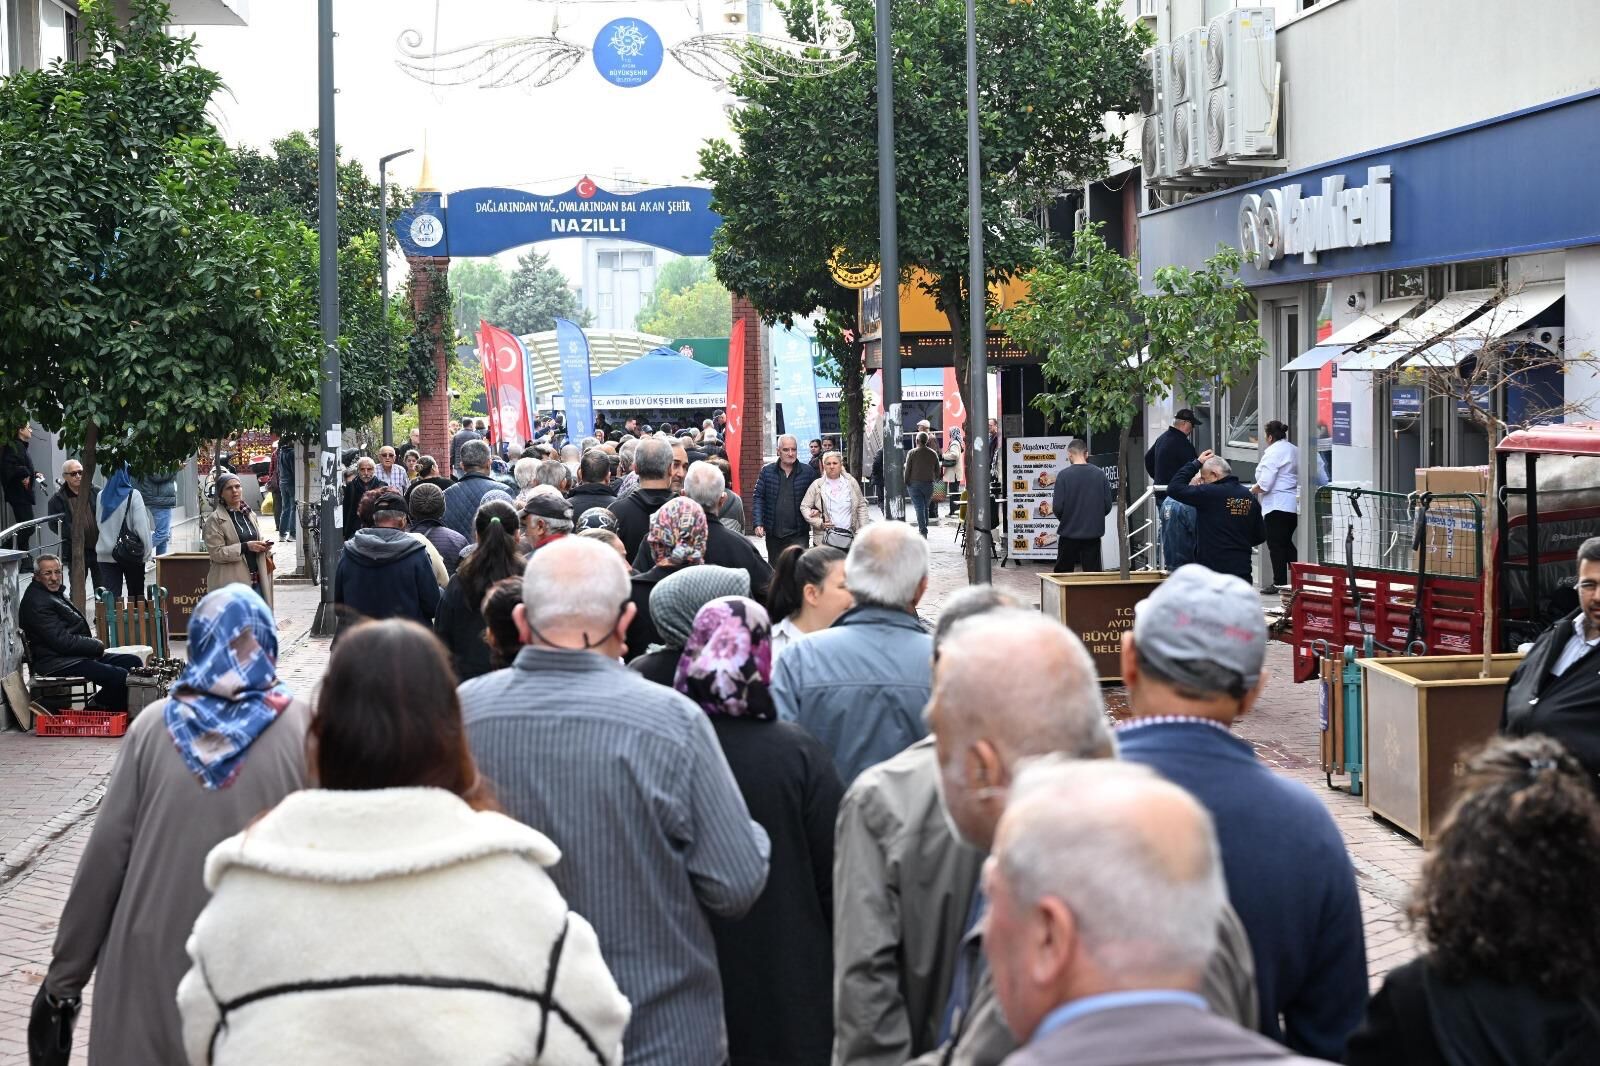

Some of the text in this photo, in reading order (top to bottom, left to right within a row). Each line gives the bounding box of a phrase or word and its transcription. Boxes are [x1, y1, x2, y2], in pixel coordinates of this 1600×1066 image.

[475, 199, 537, 213] DAĞLARINDAN
[621, 201, 637, 212] BAL
[640, 201, 665, 212] AKAN
[667, 200, 692, 214] ŞEHİR
[906, 390, 944, 399] BELEDİYES
[629, 396, 684, 407] BÜYÜKŞEHİR
[686, 396, 726, 405] BELEDİYESİ
[1115, 607, 1135, 617] T.C.
[1108, 619, 1135, 628] AYDI
[1082, 630, 1124, 642] BÜYÜ
[1093, 644, 1121, 654] BELE
